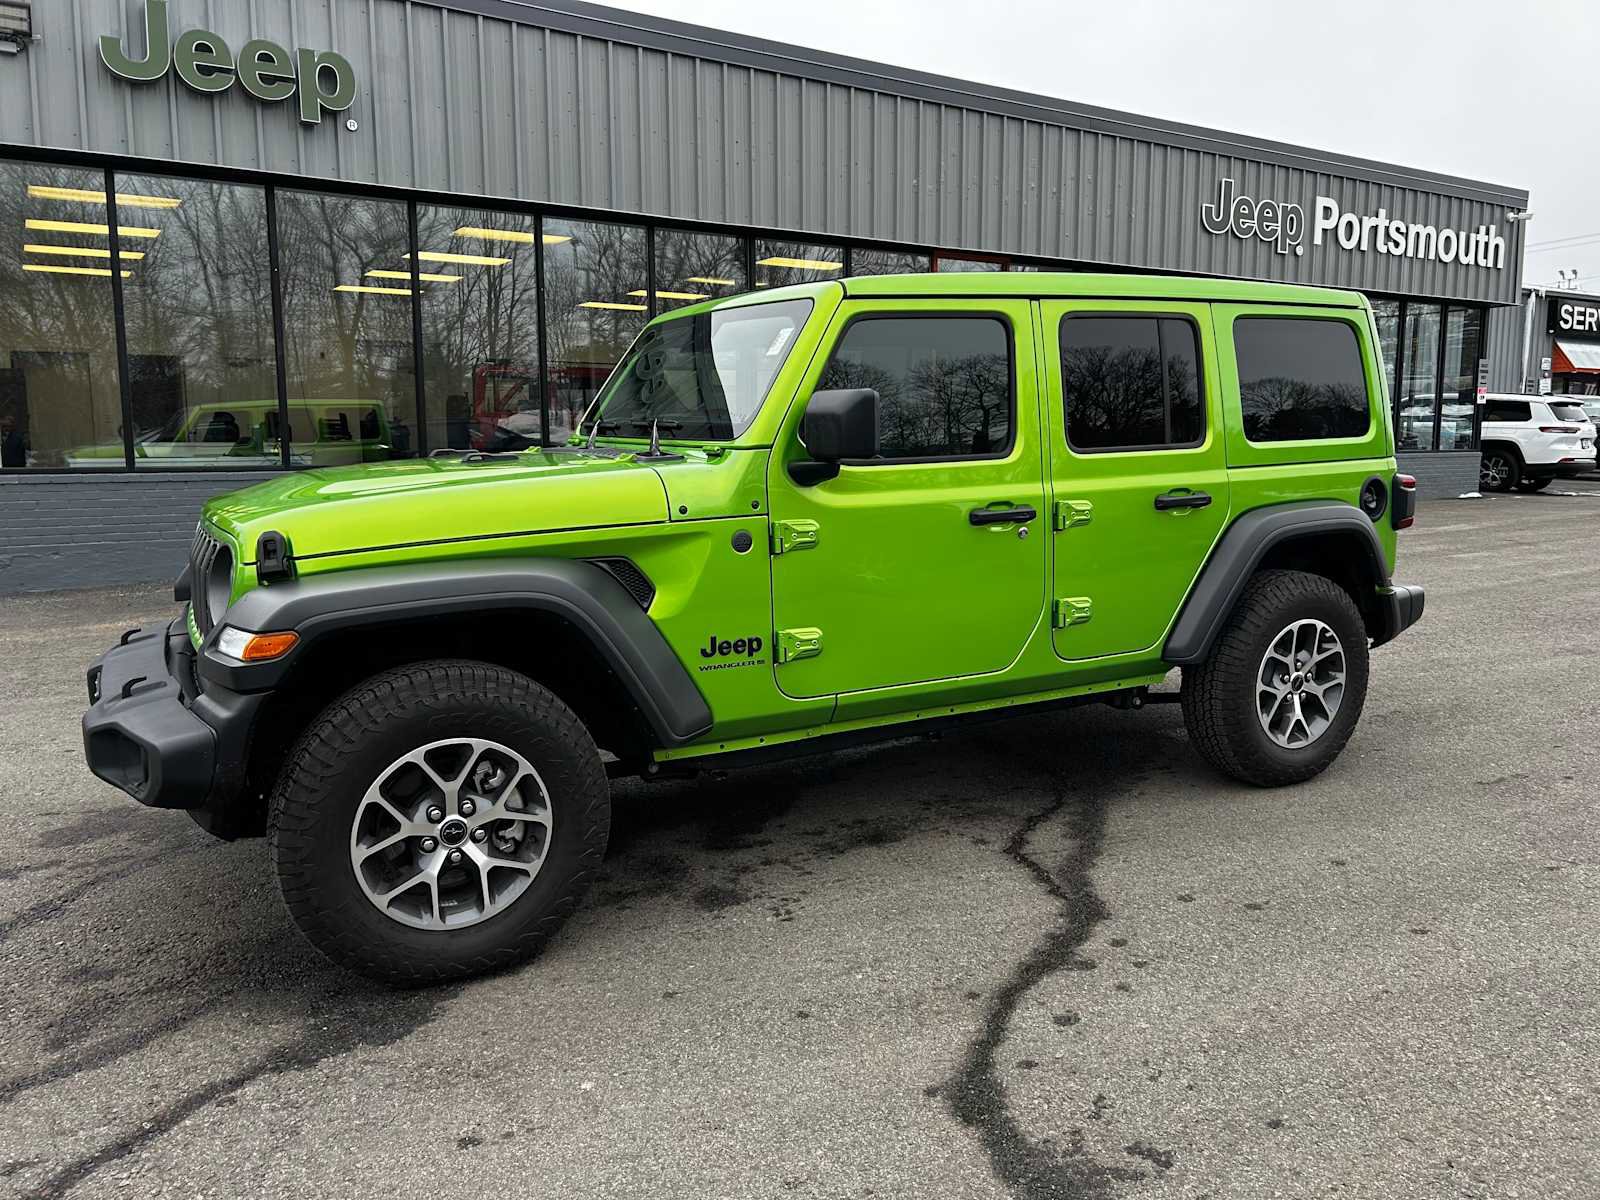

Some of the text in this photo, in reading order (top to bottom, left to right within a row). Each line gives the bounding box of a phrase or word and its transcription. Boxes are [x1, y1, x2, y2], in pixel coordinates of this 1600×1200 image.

[98, 0, 356, 124] Jeep
[1201, 178, 1506, 269] Jeep Portsmouth
[1559, 303, 1600, 332] SER
[700, 635, 763, 658] Jeep
[698, 660, 755, 672] WRANGLER
